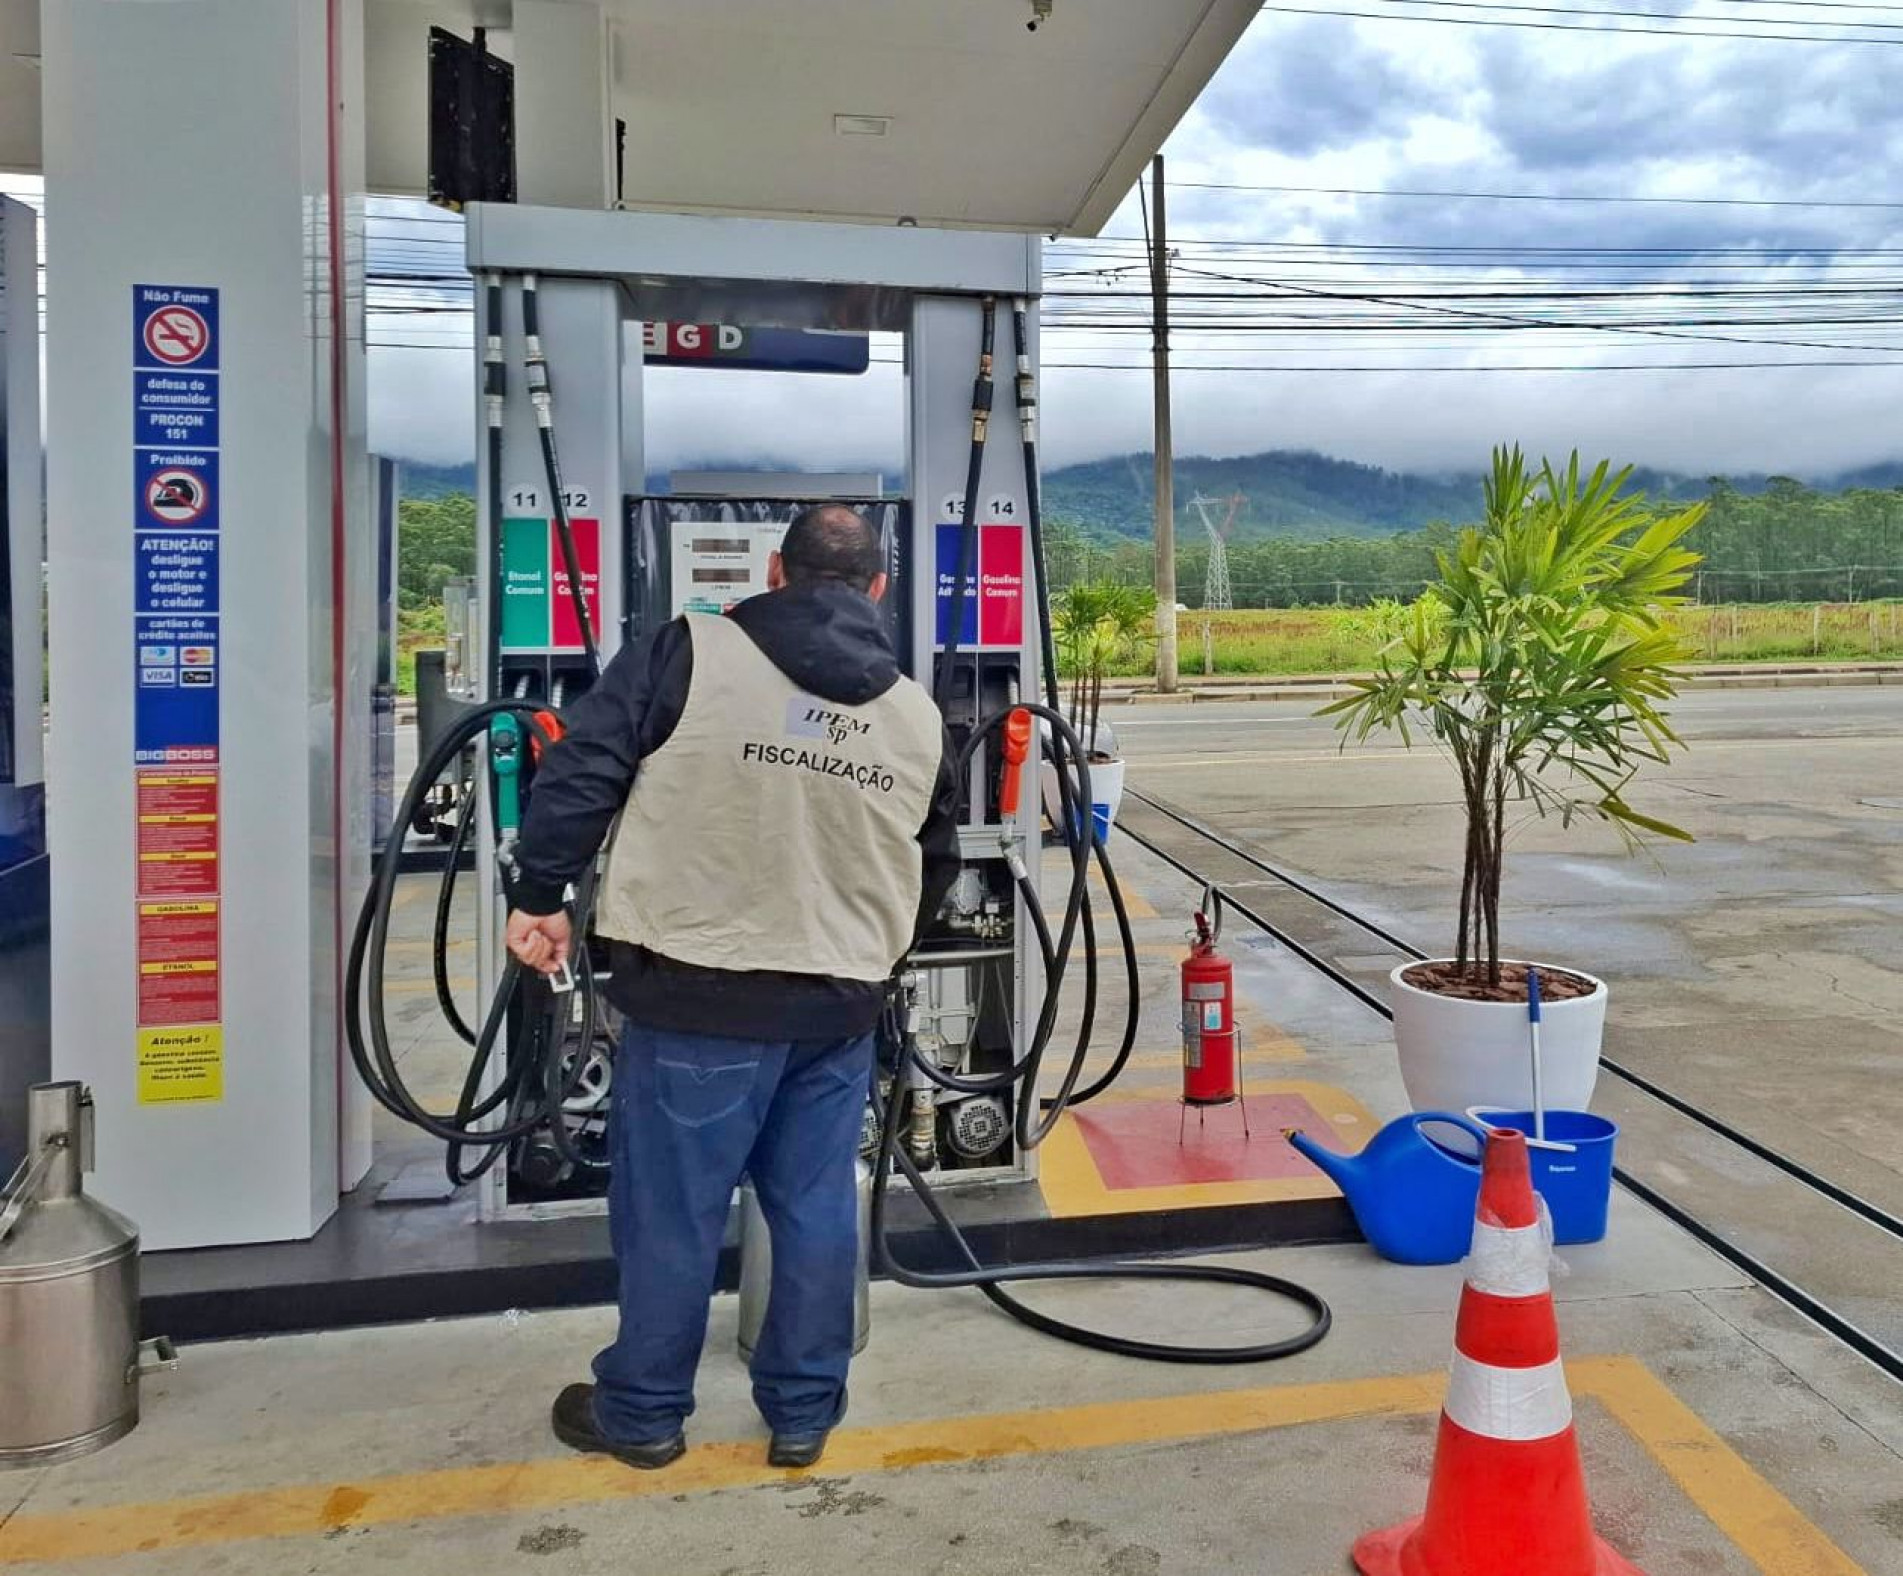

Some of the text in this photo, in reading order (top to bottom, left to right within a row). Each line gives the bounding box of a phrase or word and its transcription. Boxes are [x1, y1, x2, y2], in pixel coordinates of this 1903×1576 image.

[144, 290, 209, 304] Não Fume
[676, 324, 701, 349] G
[718, 325, 743, 350] D
[148, 379, 204, 390] defesa do
[141, 393, 211, 404] consumidor
[150, 414, 204, 426] PROCON
[166, 428, 187, 439] 151
[150, 454, 206, 466] Proibido
[513, 492, 536, 508] 11
[561, 493, 588, 508] 12
[945, 501, 967, 515] 13
[991, 501, 1014, 515] 14
[141, 537, 214, 553] ATENÇÃO!
[151, 554, 204, 568] desligue
[148, 569, 207, 580] o motor e
[508, 571, 541, 581] Etanol
[983, 574, 1021, 584] Gasolina
[151, 581, 204, 596] desligue
[505, 584, 545, 595] Comum
[150, 597, 205, 608] o celular
[192, 618, 205, 628] de
[146, 671, 172, 681] VISA
[803, 708, 871, 735] IPEM
[743, 743, 894, 793] FISCALIZAÇÃO
